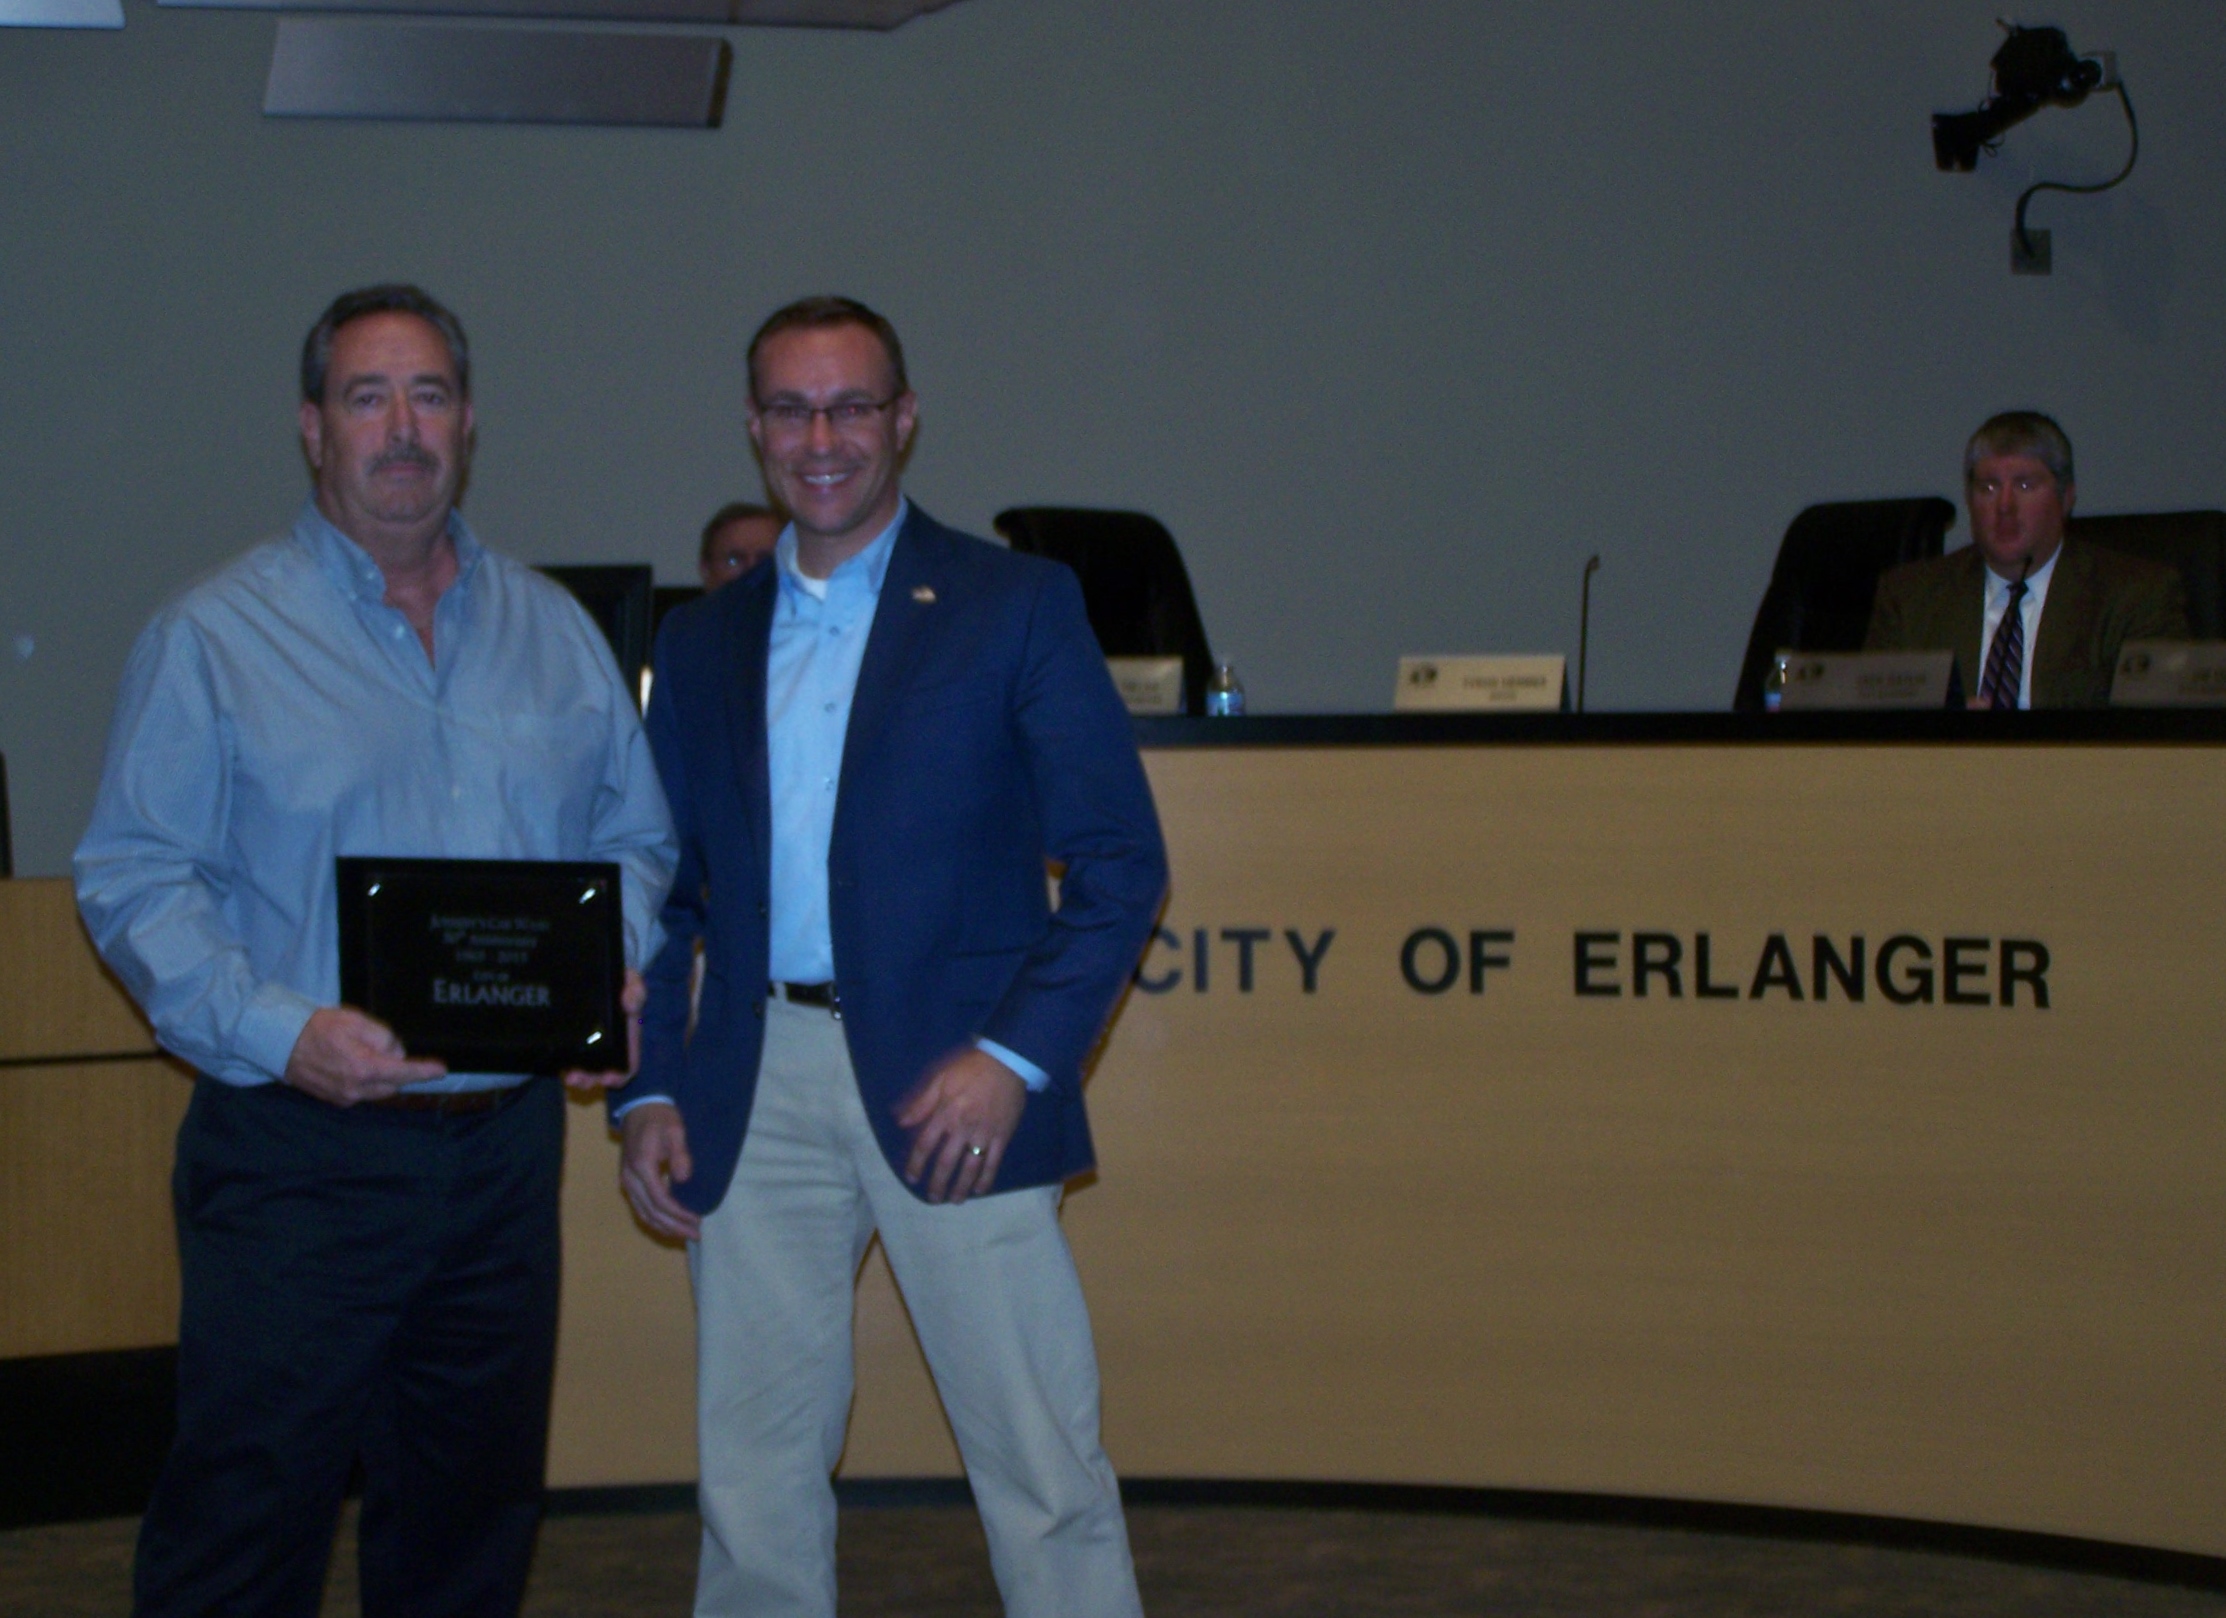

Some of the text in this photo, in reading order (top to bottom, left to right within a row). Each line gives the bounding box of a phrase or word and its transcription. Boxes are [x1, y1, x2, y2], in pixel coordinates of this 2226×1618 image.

[433, 978, 551, 1007] ERLANGER
[1134, 927, 2053, 1010] CITY OF ERLANGER
